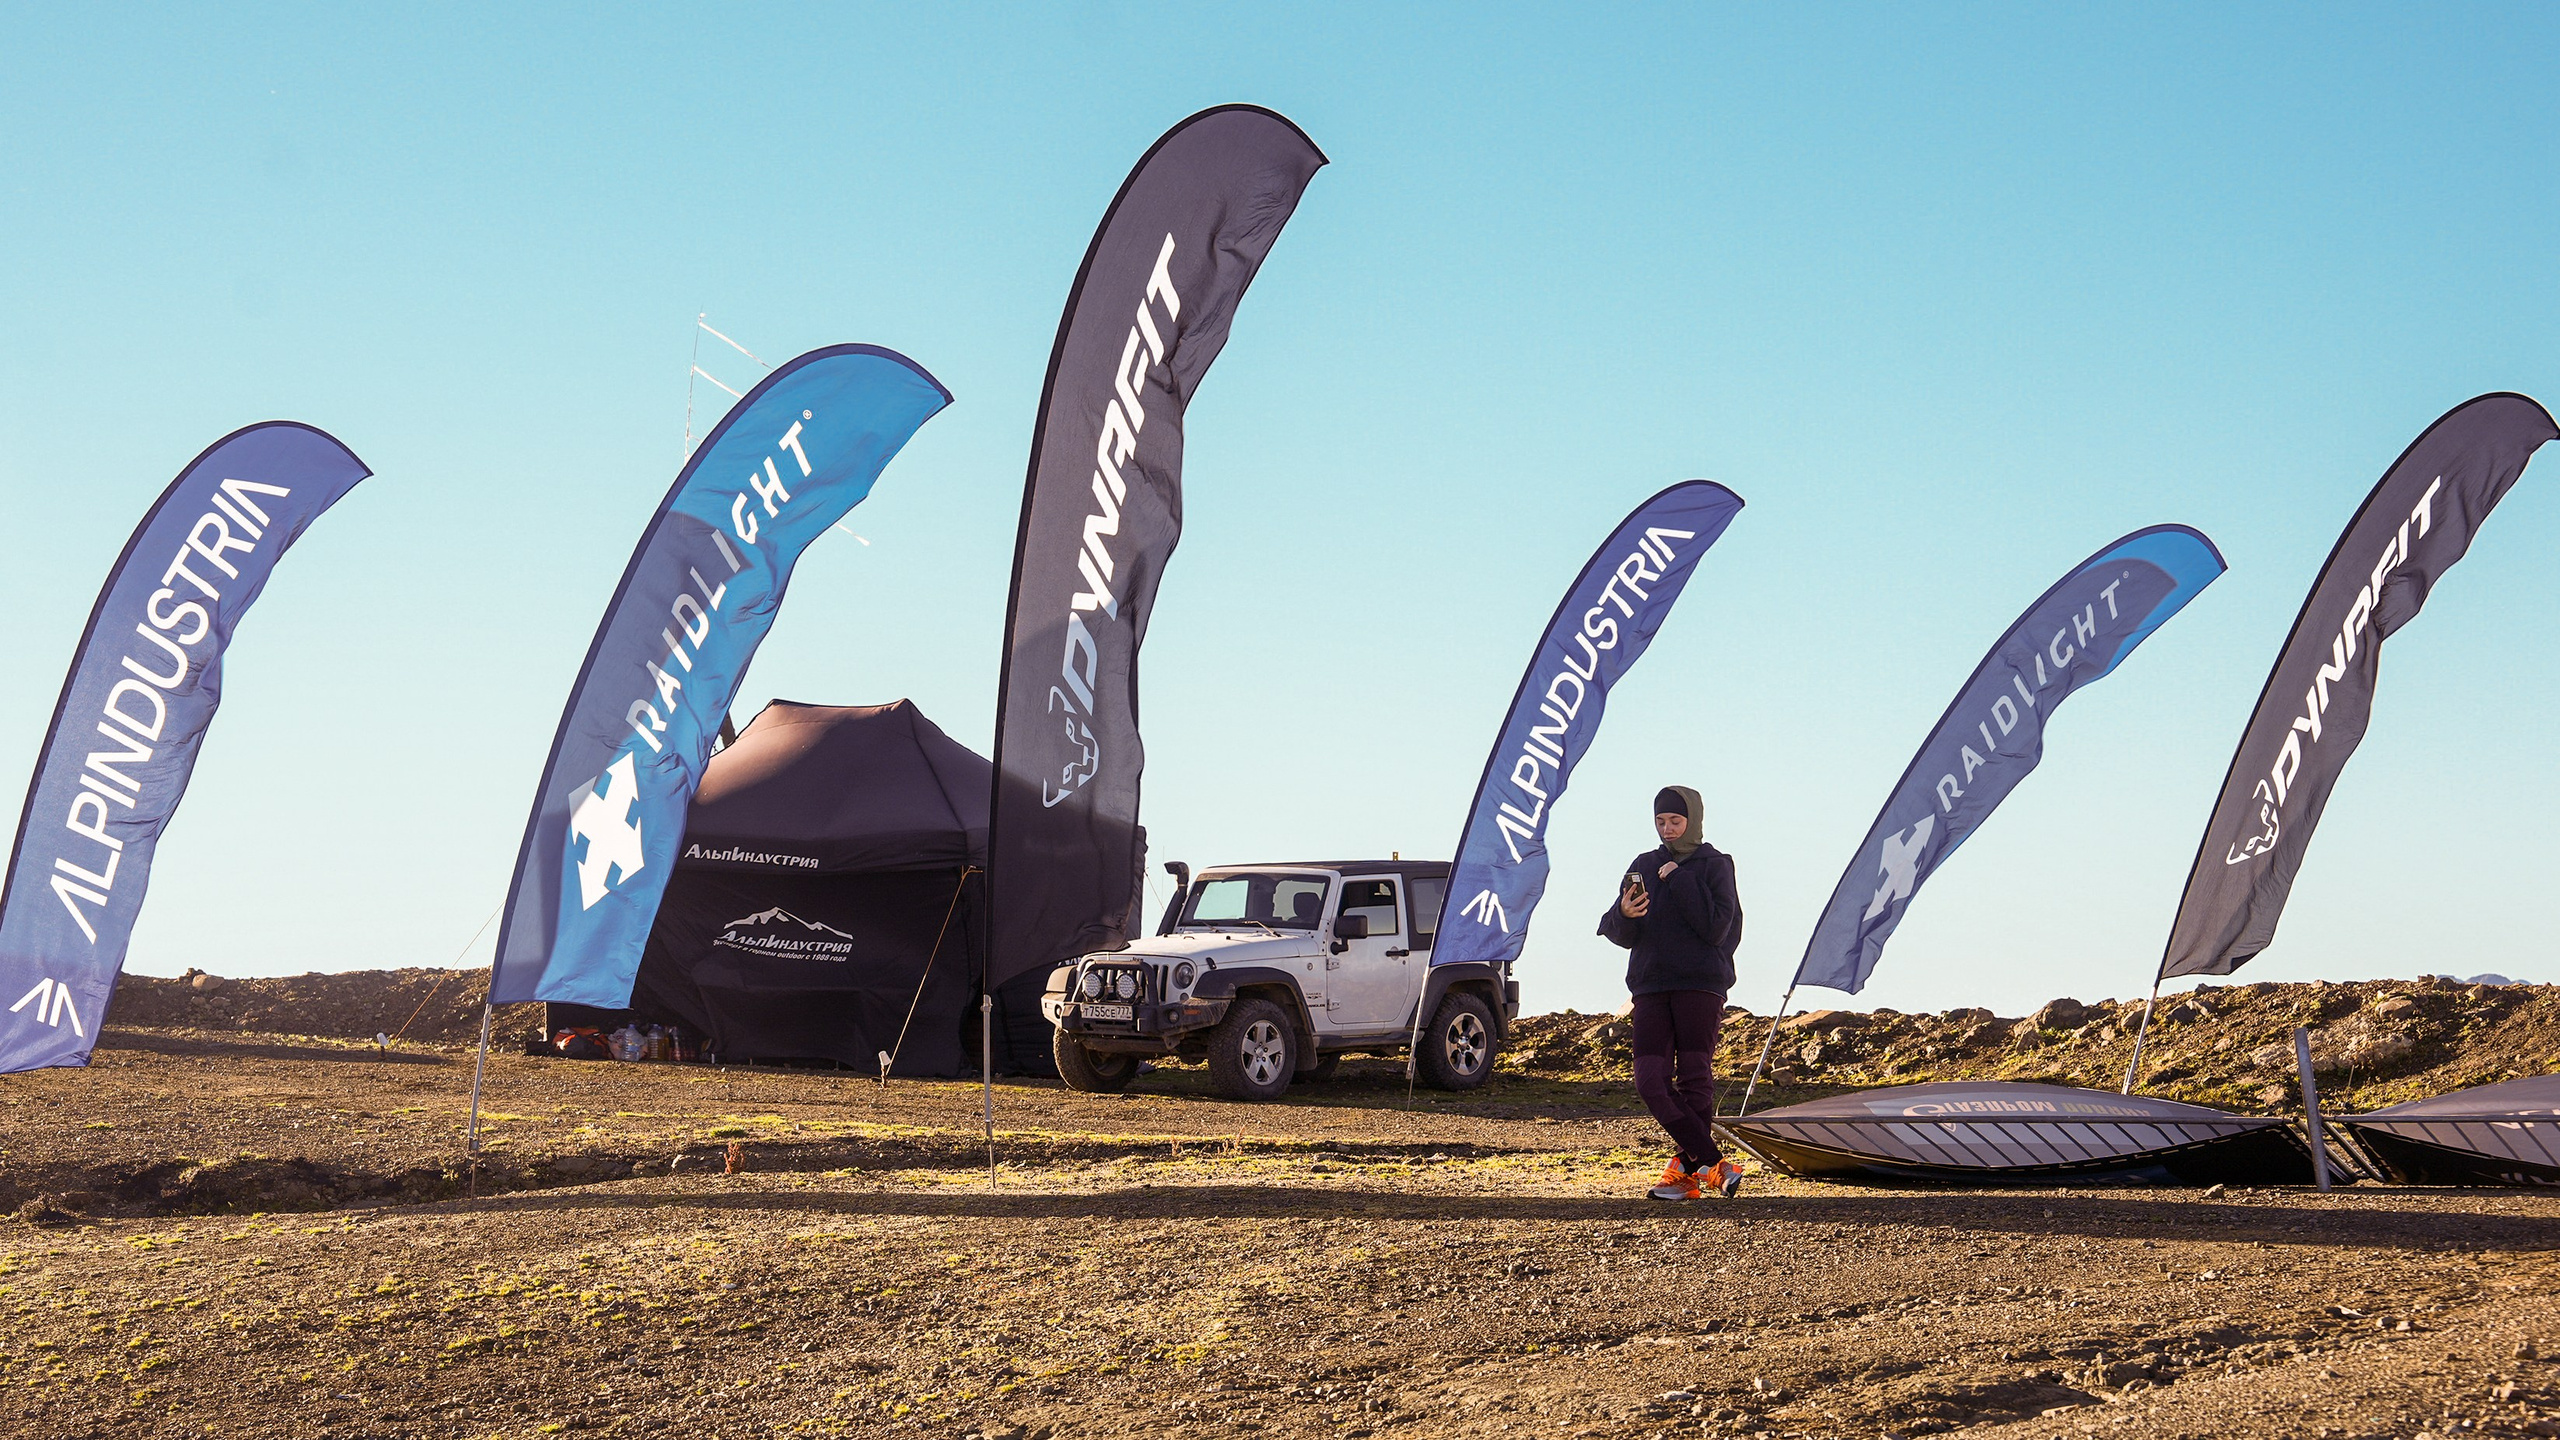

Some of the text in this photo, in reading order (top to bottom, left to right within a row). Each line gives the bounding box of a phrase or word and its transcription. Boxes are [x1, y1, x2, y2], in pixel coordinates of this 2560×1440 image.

[1062, 232, 1182, 715] DYNAFIT
[2271, 475, 2441, 806] DYNAFIT
[50, 478, 290, 944] ALPINDUSTRIA
[1496, 527, 1695, 863] ALPINDUSTRIA
[777, 951, 805, 960] outdoor
